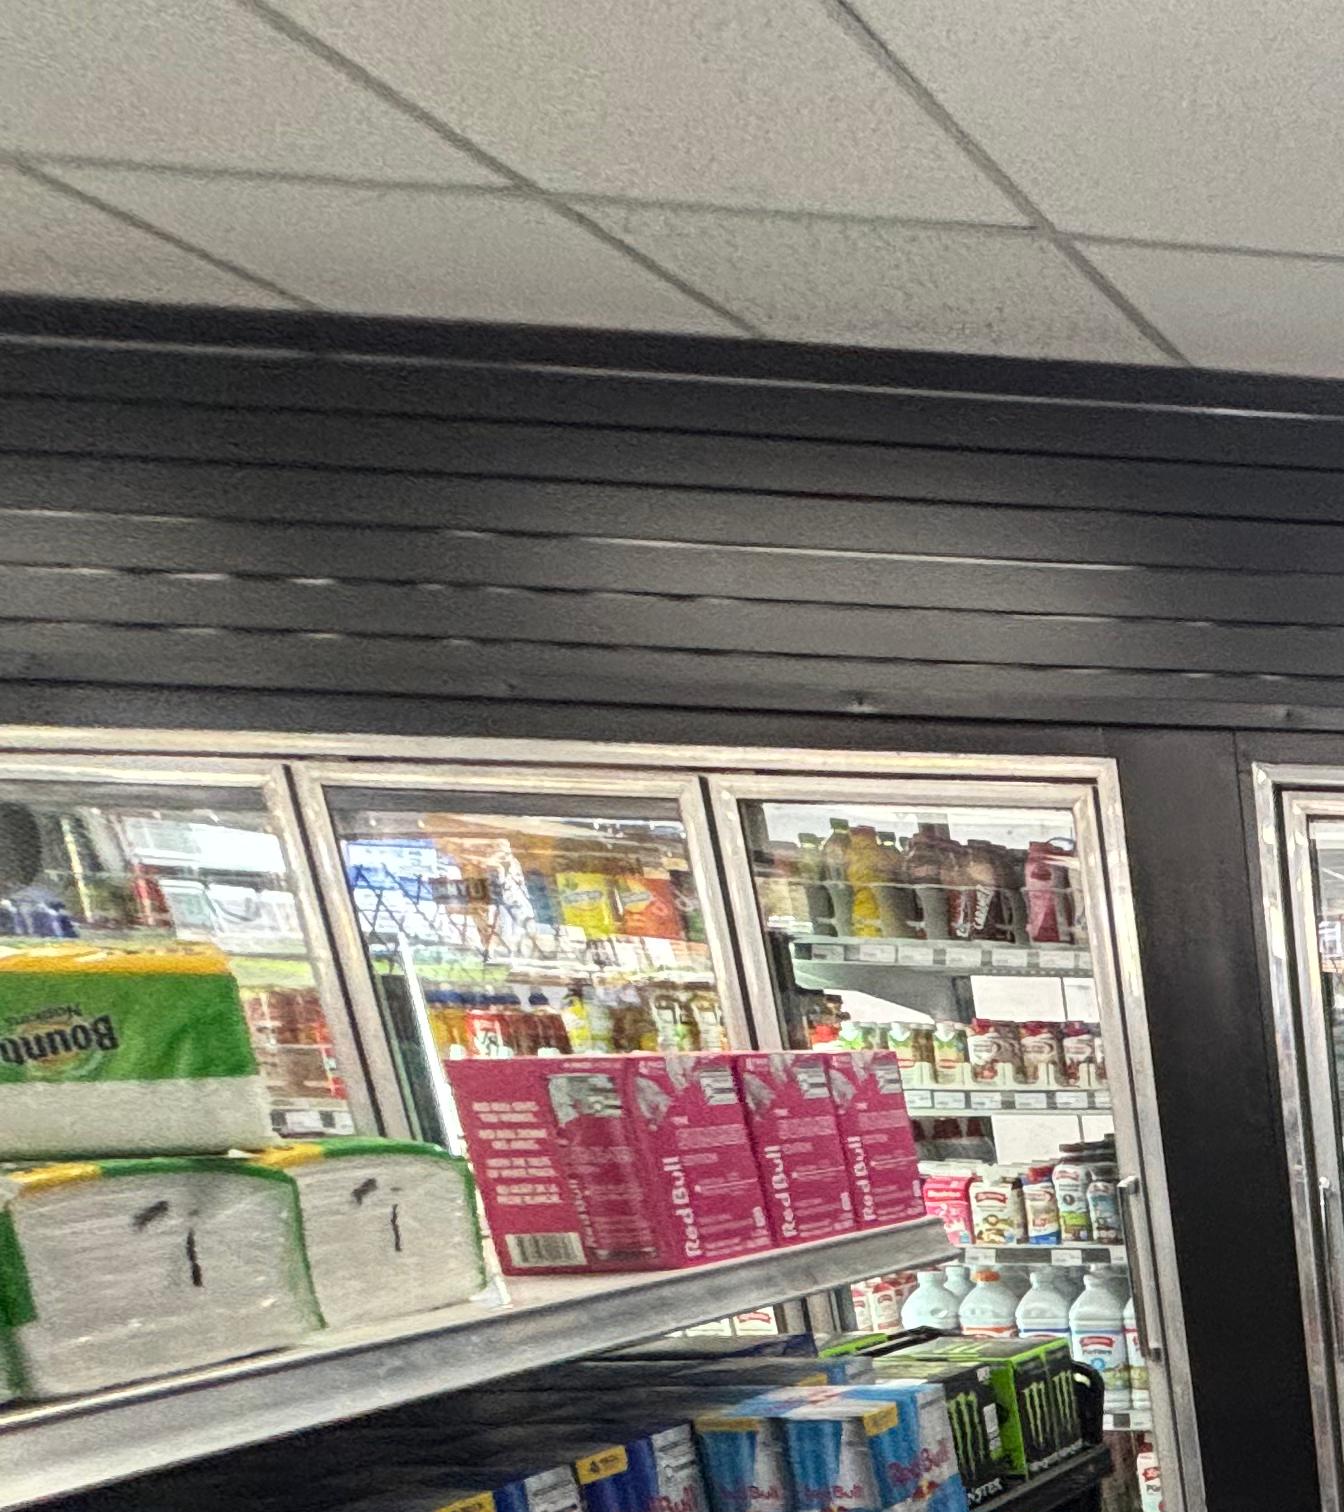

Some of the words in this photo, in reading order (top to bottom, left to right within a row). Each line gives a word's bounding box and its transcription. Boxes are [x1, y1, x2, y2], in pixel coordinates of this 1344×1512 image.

[662, 1155, 690, 1206] Bull
[764, 1145, 789, 1191] Bull
[846, 1136, 870, 1180] Bull
[676, 1206, 701, 1258] Red
